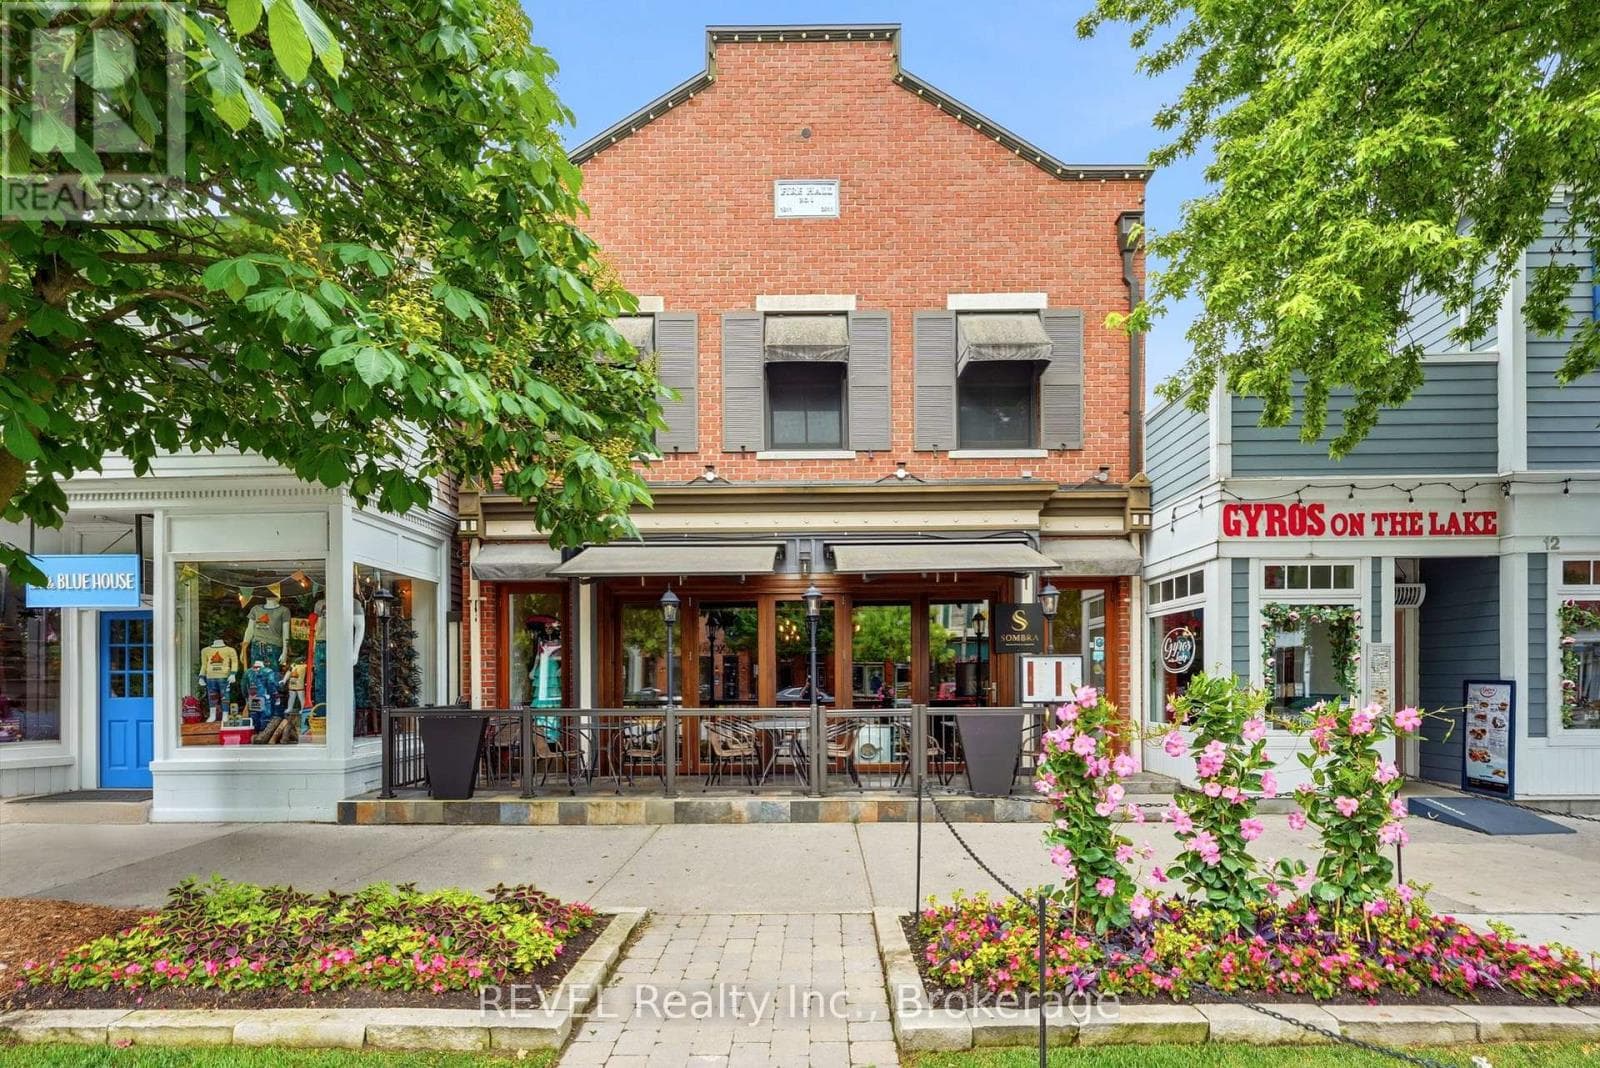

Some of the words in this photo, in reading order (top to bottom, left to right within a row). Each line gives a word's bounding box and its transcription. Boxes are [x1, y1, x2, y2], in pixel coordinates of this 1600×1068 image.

[1223, 503, 1326, 537] GYROS
[1331, 513, 1364, 536] ON
[1371, 512, 1424, 536] THE
[1429, 511, 1497, 536] LAKE
[1543, 536, 1560, 550] 12
[57, 572, 89, 590] BLUE
[92, 572, 134, 590] HOUSE
[1001, 634, 1039, 642] SOMBRA
[1164, 637, 1191, 660] Gyros
